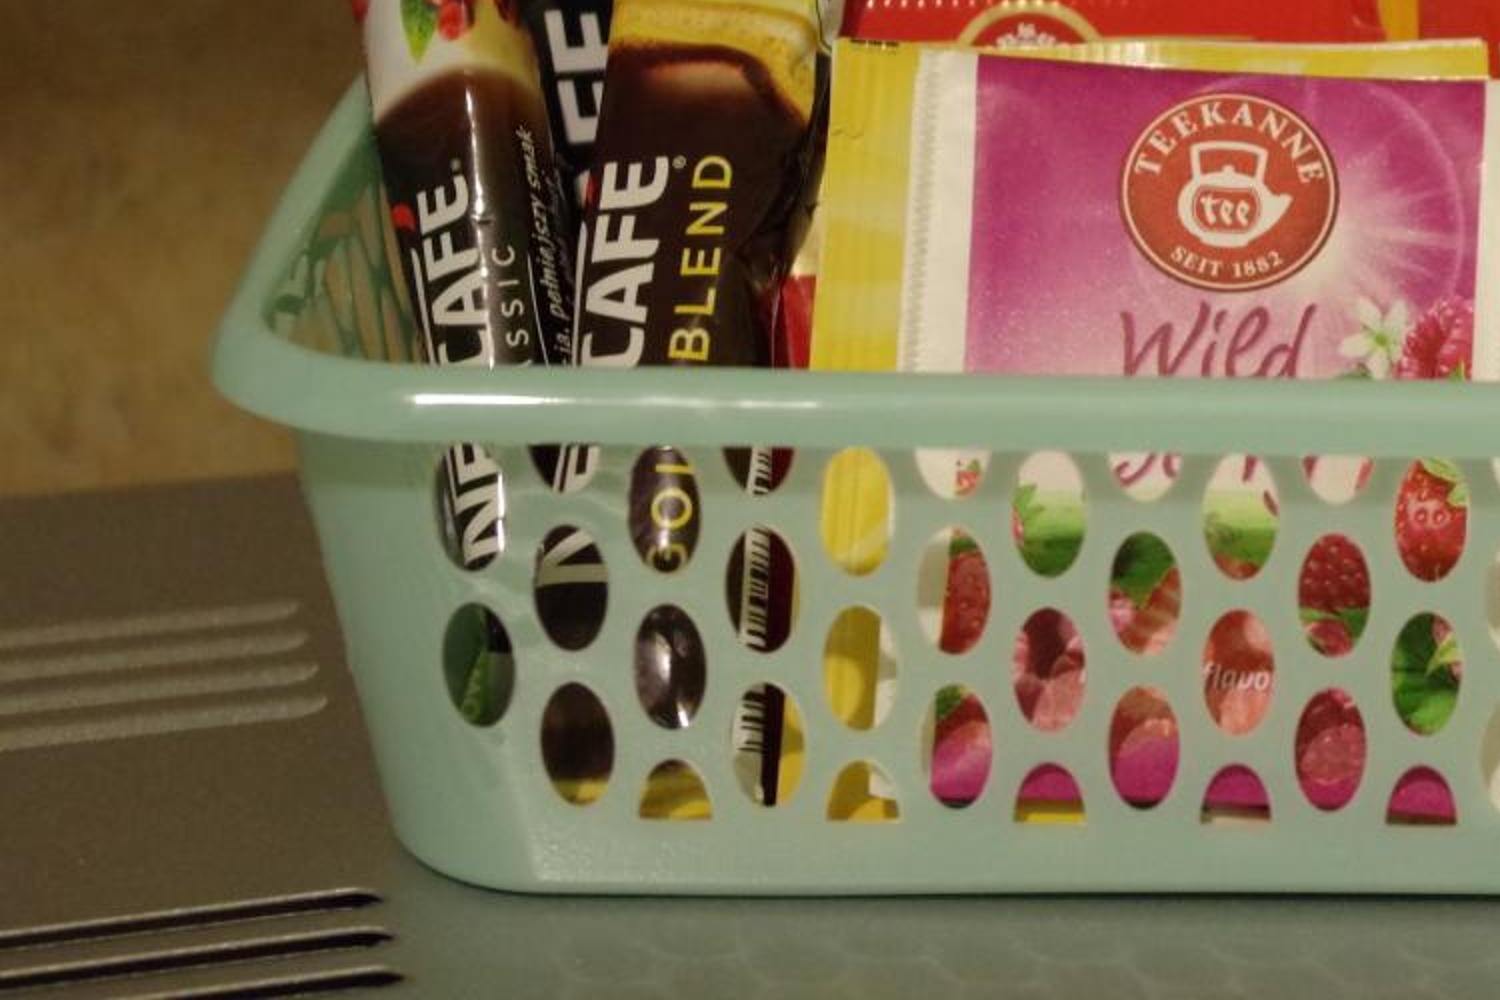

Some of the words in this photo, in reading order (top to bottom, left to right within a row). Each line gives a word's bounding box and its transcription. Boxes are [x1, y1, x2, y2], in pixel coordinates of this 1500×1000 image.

[1134, 100, 1326, 184] TEEKANNE
[1200, 193, 1252, 227] tee
[668, 155, 733, 361] BLEND
[1170, 245, 1223, 278] SEIT
[1233, 250, 1284, 279] 1882
[492, 244, 532, 367] SSIC
[1119, 300, 1318, 378] Wild
[1203, 663, 1271, 692] flavo
